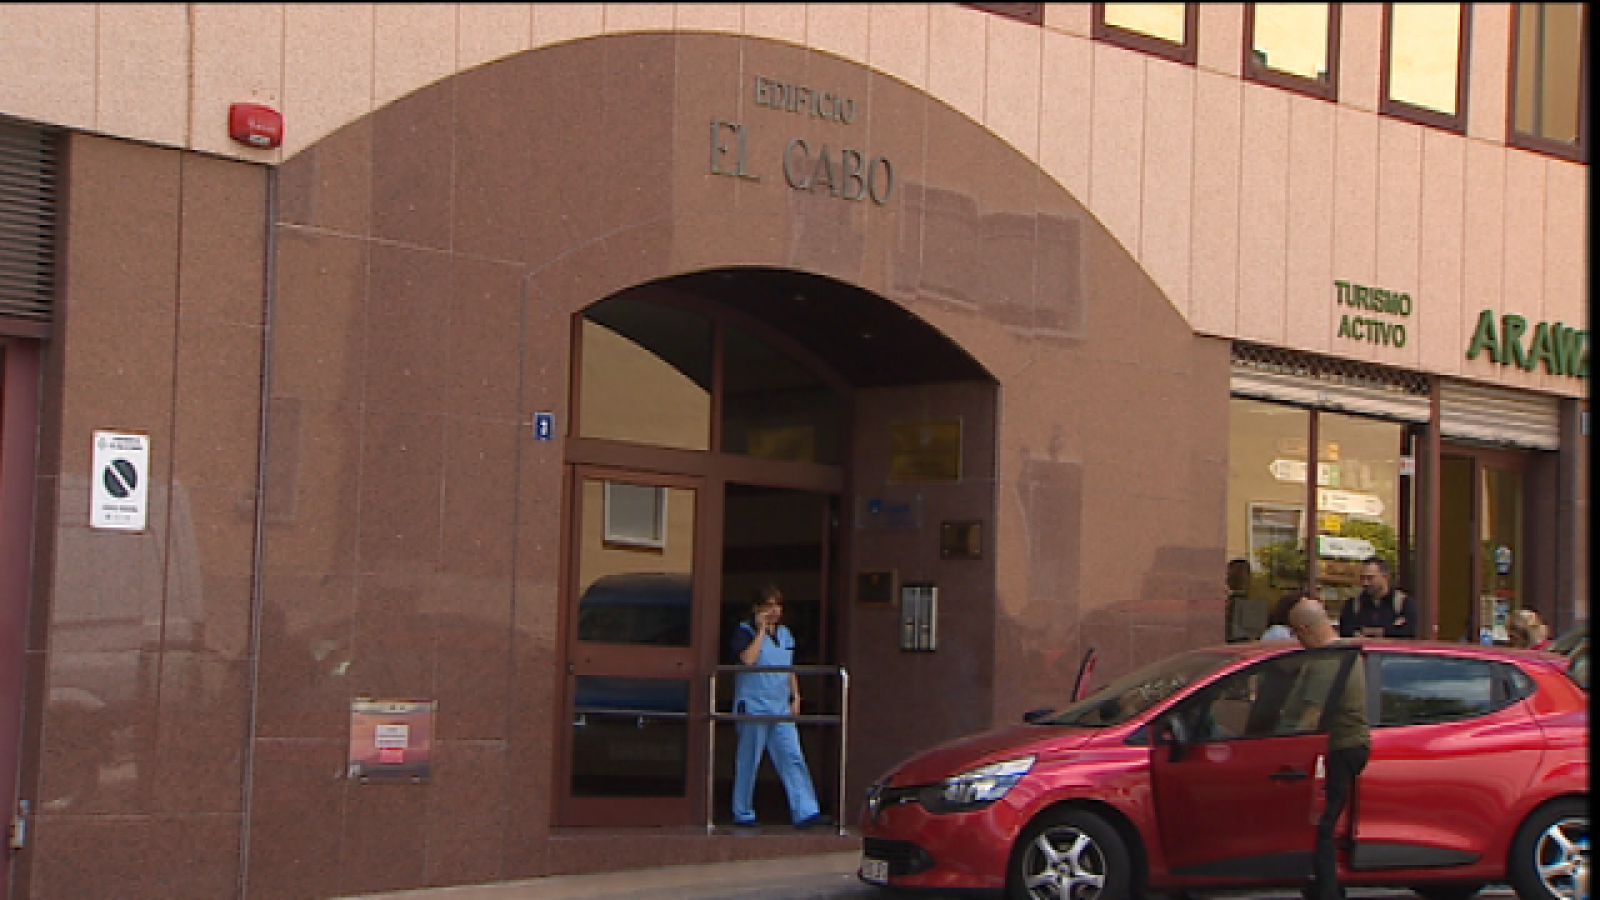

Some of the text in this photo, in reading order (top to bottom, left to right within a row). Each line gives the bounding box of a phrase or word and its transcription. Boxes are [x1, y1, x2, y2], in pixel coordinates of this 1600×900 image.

[755, 75, 856, 125] EDIFICIO
[710, 121, 894, 205] EL CABO
[1335, 279, 1412, 317] TURISMO
[1337, 314, 1406, 348] ACTIVO
